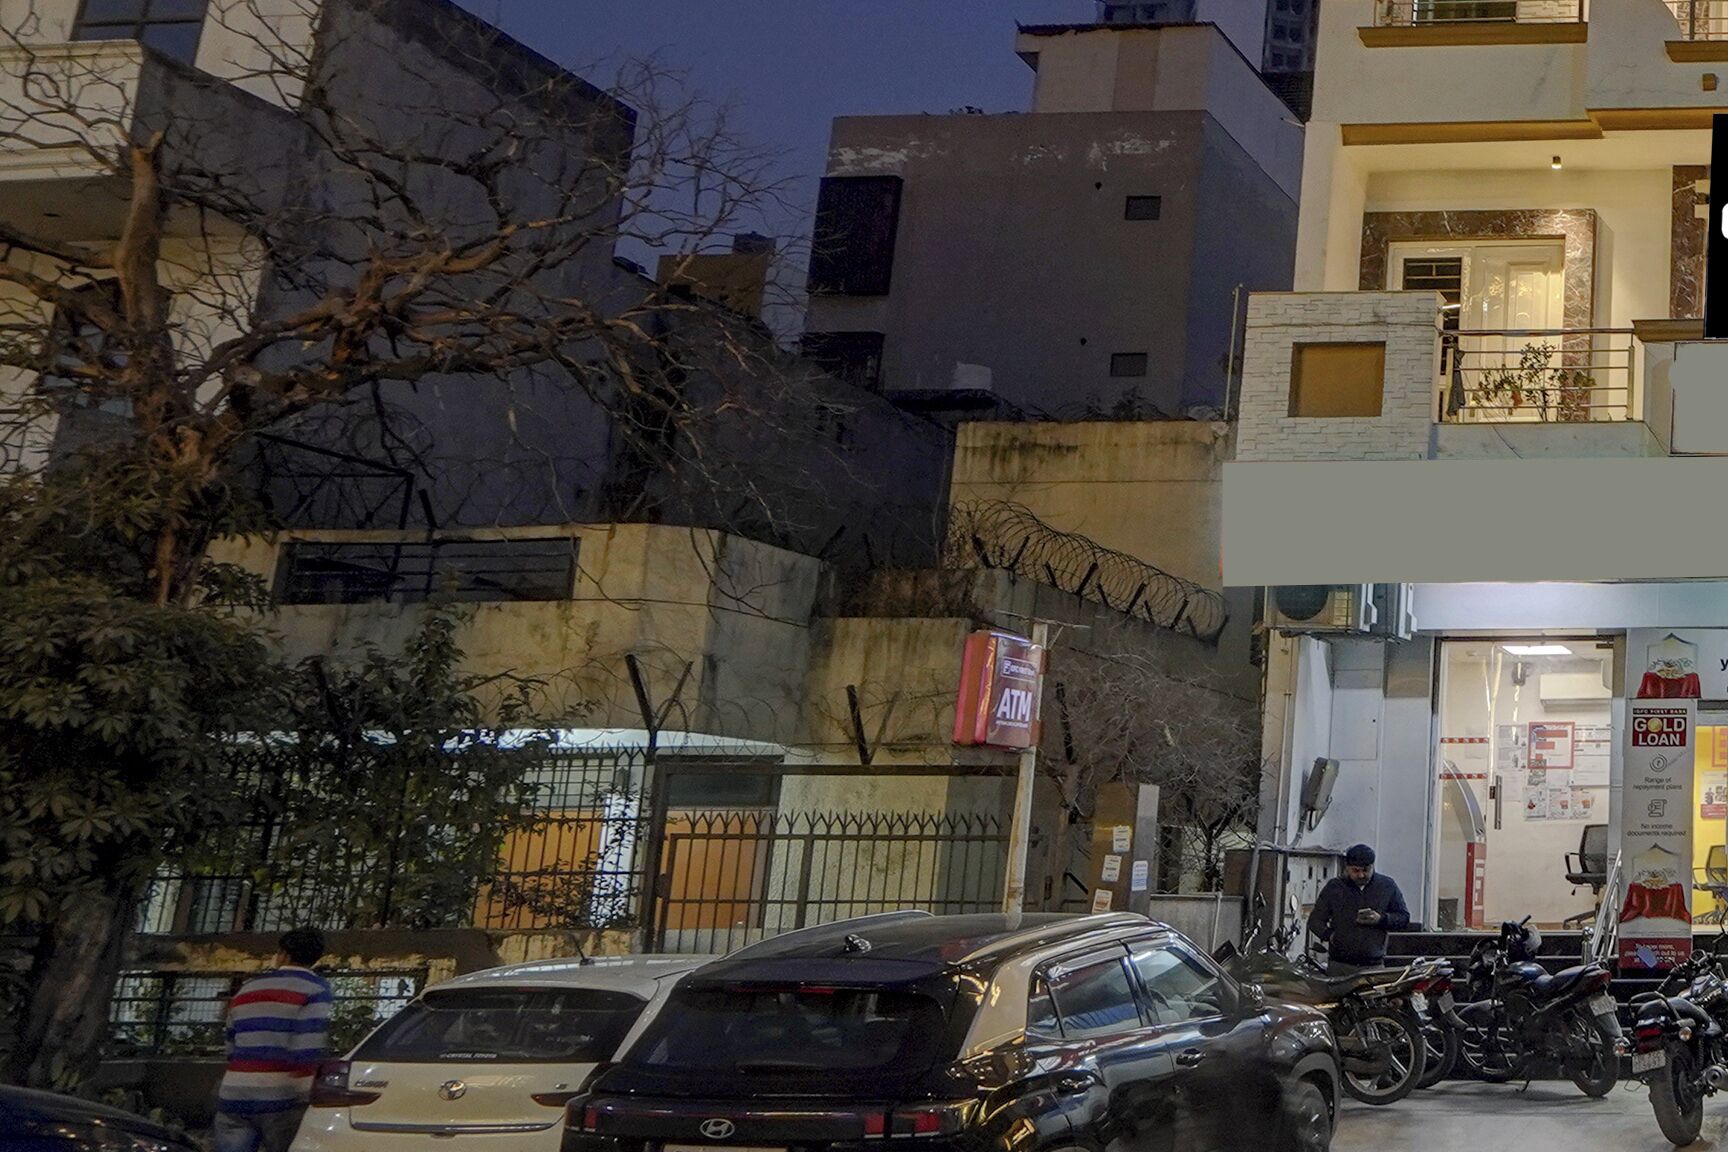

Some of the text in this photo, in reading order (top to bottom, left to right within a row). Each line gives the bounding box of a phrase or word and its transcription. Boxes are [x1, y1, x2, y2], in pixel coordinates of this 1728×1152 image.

[996, 688, 1032, 722] ATM
[1634, 717, 1685, 732] GOLD
[1638, 733, 1680, 746] LOAN
